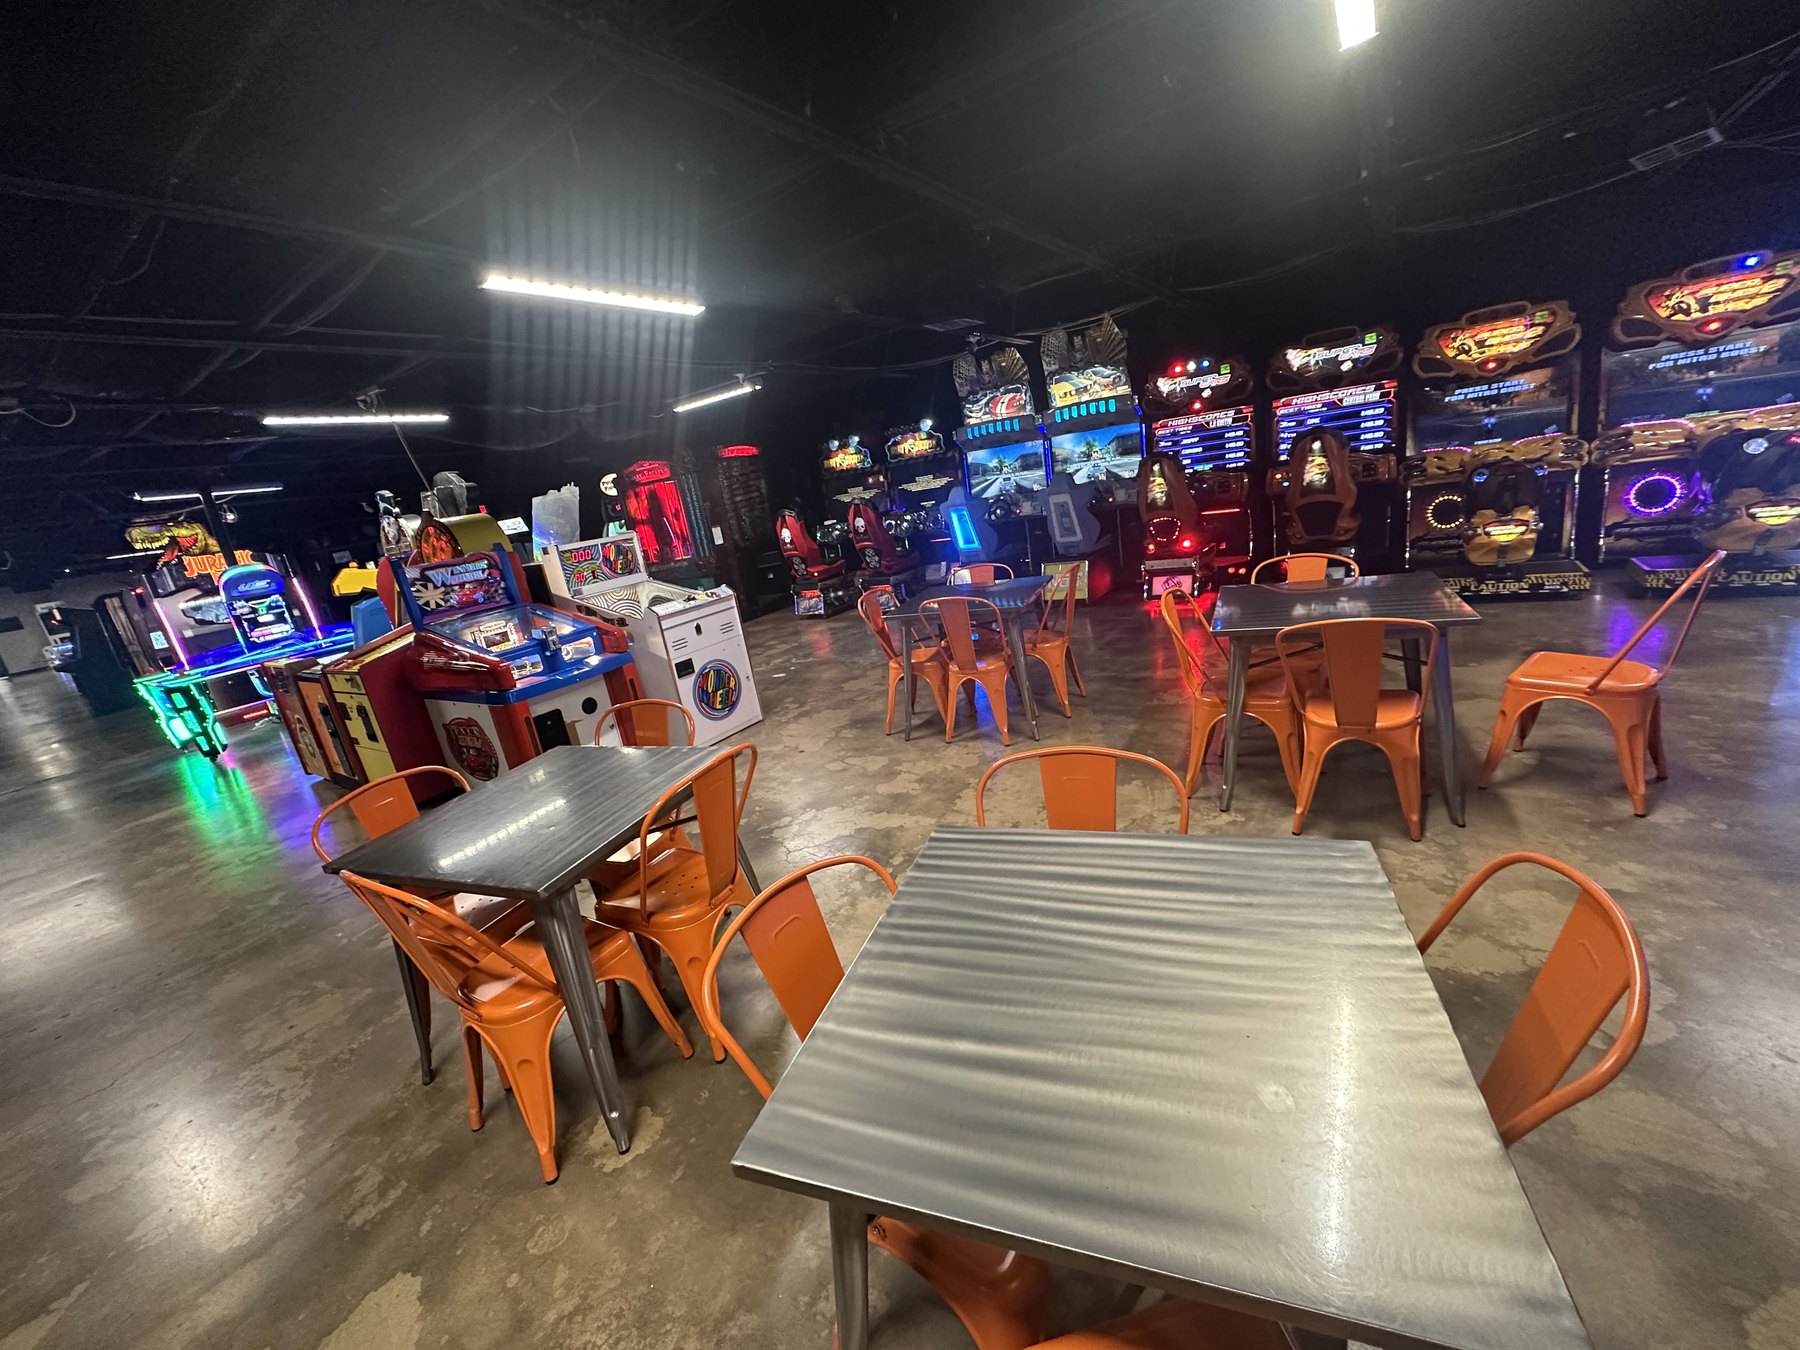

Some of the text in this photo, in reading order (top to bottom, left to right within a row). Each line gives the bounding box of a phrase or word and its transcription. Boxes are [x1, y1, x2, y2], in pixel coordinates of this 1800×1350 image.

[1648, 345, 1768, 370] FOR NITRO BOOST
[1661, 341, 1753, 361] PRESS START
[1292, 385, 1376, 405] HIGHSCORES
[1444, 393, 1465, 402] FOR
[1500, 382, 1537, 393] BOOST
[1454, 378, 1526, 395] PRESS START
[1167, 410, 1235, 427] HIGHSCORES
[182, 549, 256, 578] JURASIC
[1162, 576, 1181, 590] RAW
[1470, 581, 1530, 591] CAUTION
[1717, 569, 1797, 583] CAUTION
[699, 669, 736, 693] WONDER
[700, 688, 736, 709] WHEEL
